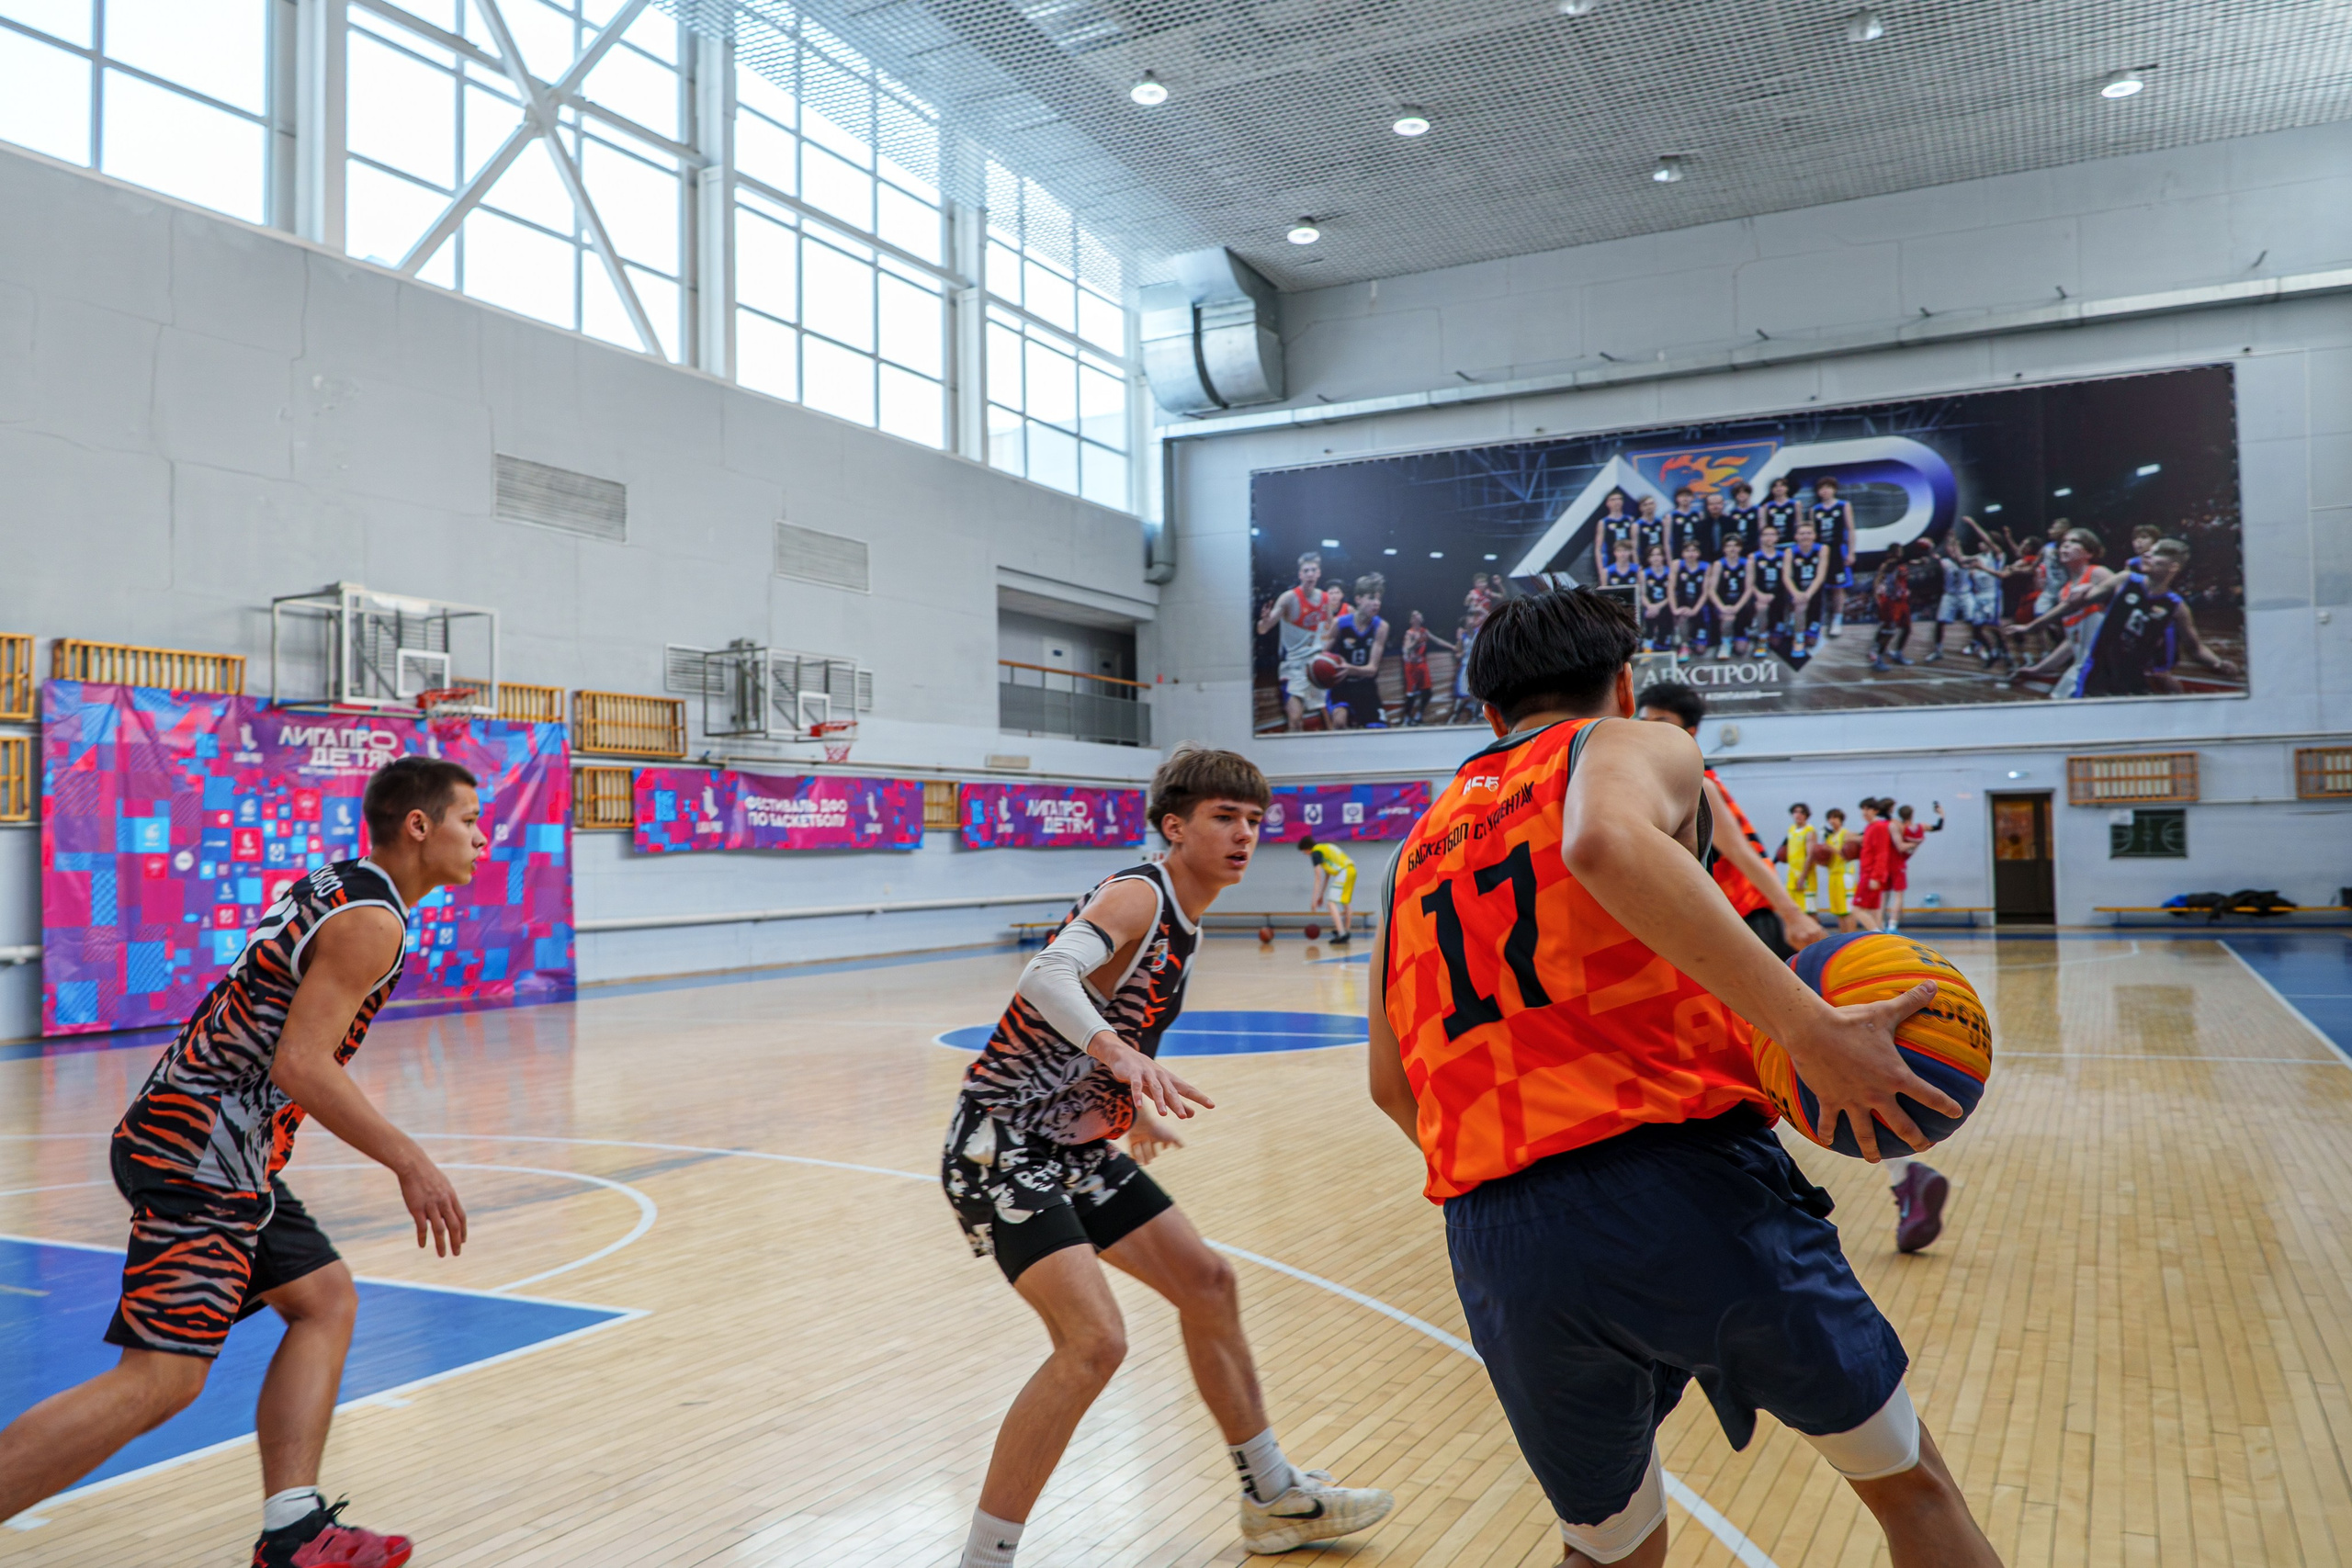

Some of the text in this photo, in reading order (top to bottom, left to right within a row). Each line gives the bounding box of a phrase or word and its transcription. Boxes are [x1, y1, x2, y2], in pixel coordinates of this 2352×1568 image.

[748, 811, 768, 827] ПО
[1408, 822, 1470, 874] БАСКЕТБОЛ
[1420, 840, 1554, 1043] 17
